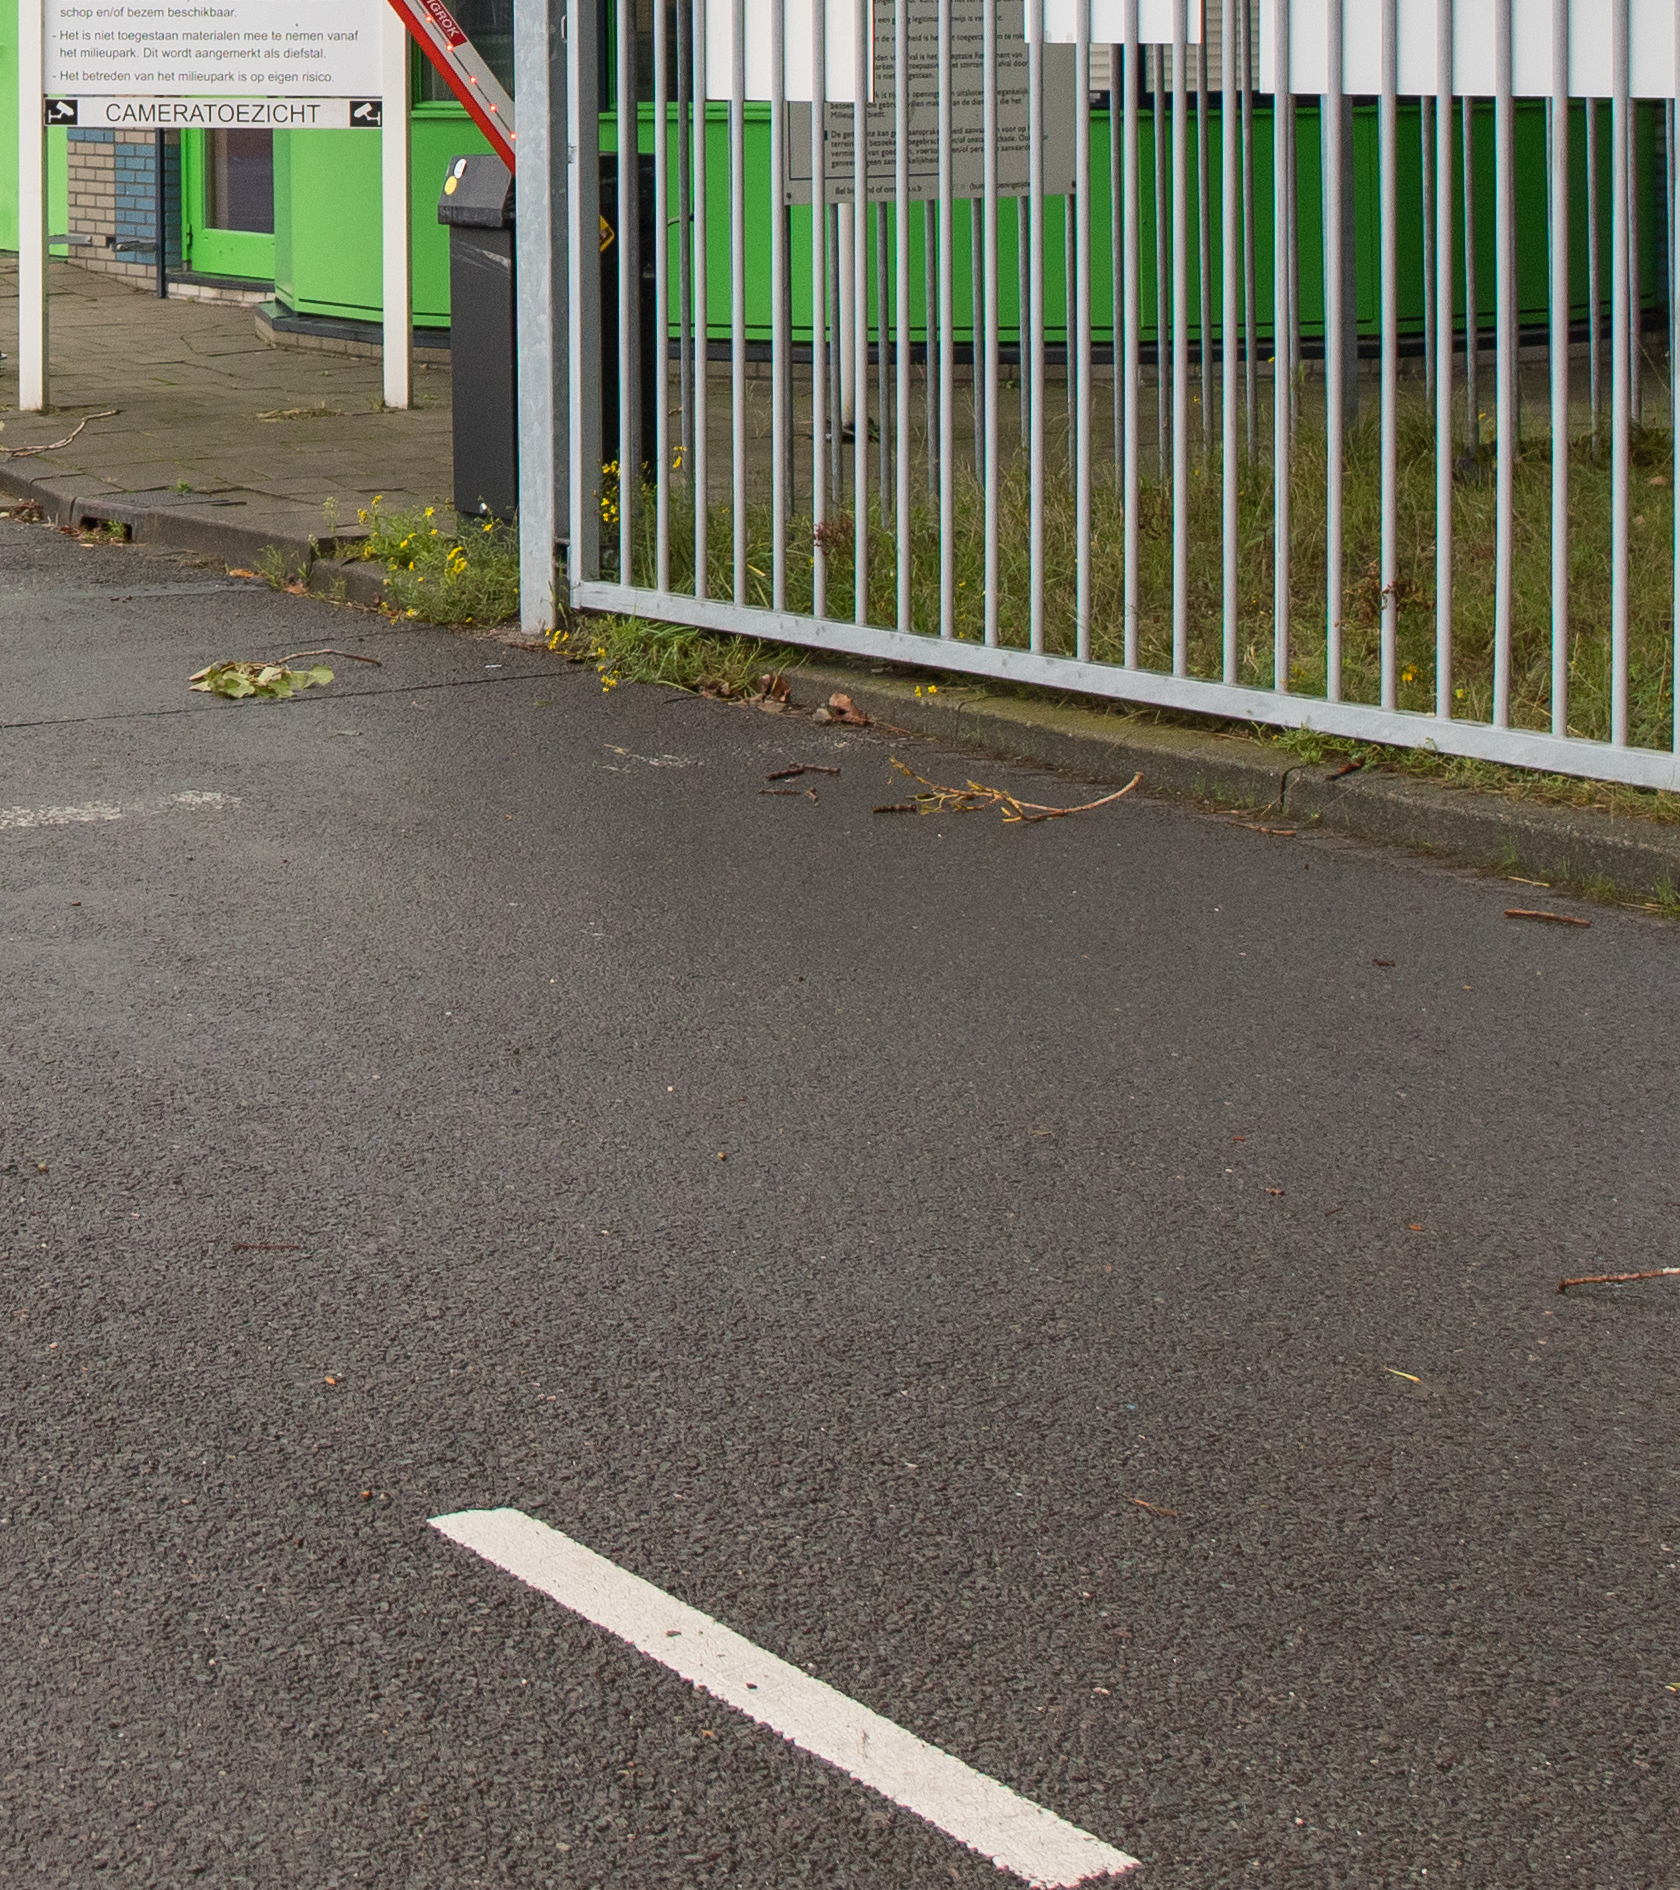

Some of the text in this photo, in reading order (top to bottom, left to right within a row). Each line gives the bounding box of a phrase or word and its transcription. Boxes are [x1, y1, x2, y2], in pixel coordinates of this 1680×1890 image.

[60, 7, 236, 19] schop en/of bezem beschikbaar.
[60, 30, 359, 43] Het niet toegestaan materialen mee nemen vanaf
[60, 47, 326, 61] het milieupark. Dit wordt aangemerkt als diefstal.
[60, 71, 334, 85] Het betreden van het milieupark eigen risico.
[105, 103, 321, 124] CAMERATOEZICHT
